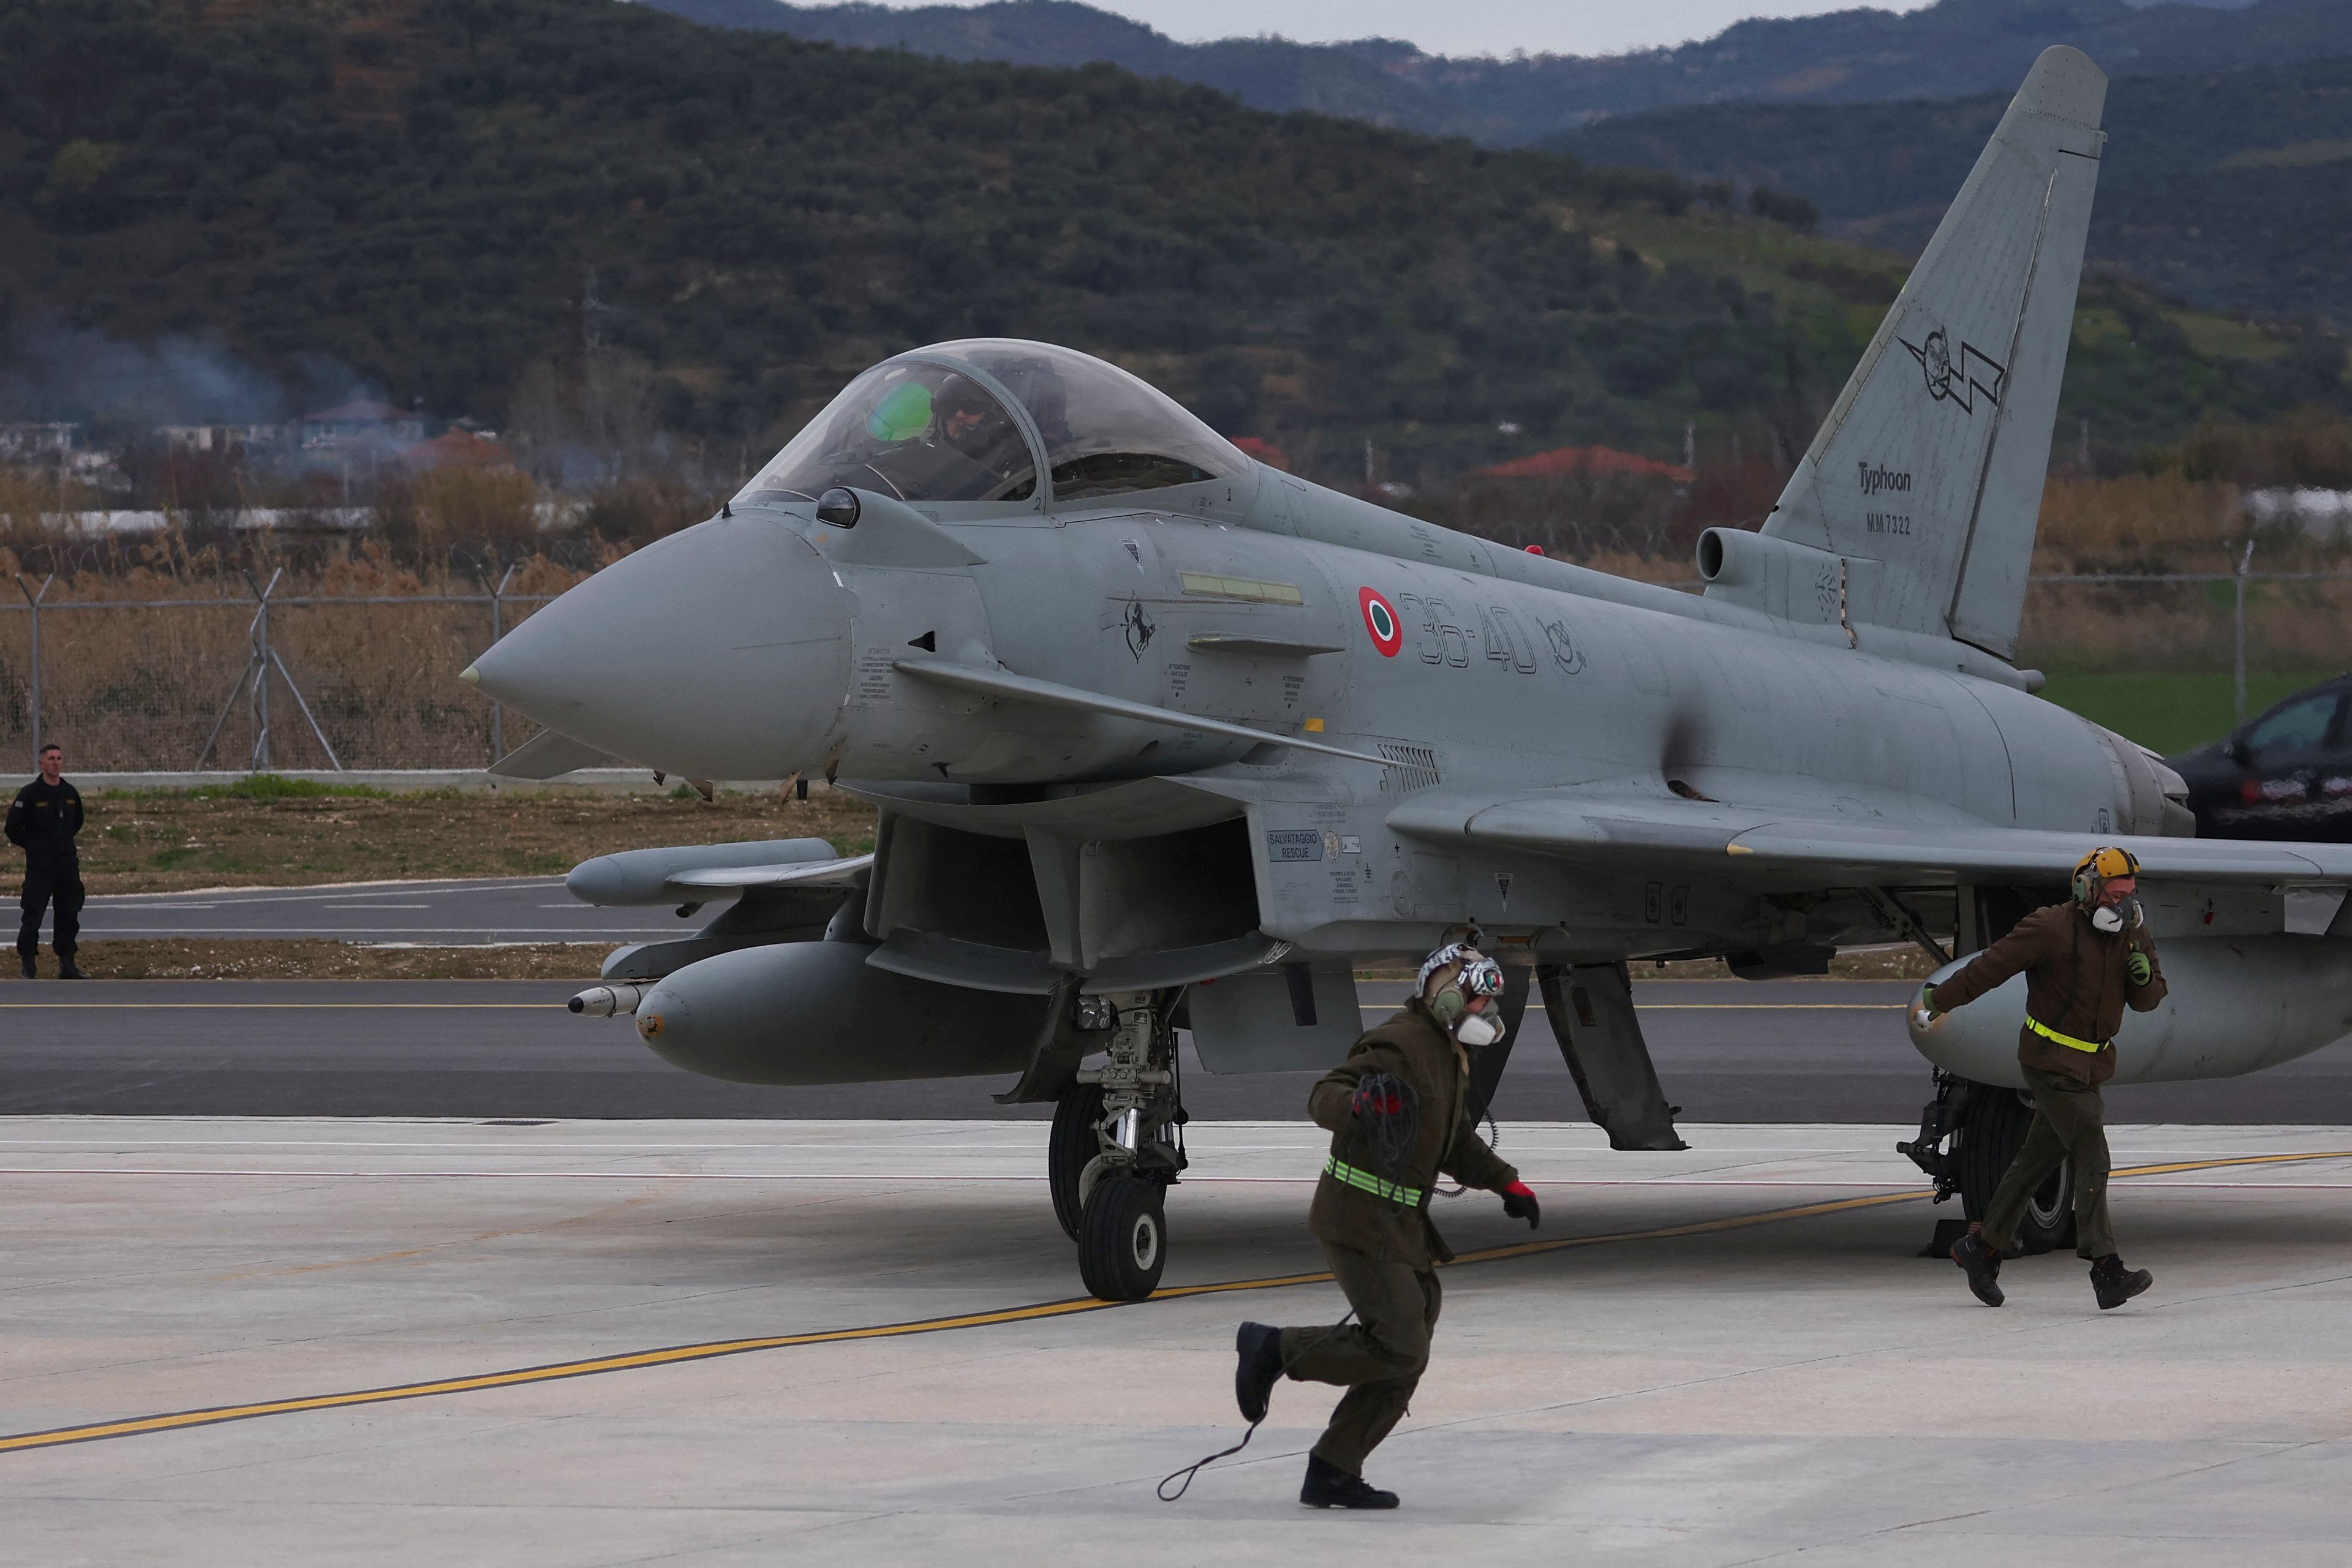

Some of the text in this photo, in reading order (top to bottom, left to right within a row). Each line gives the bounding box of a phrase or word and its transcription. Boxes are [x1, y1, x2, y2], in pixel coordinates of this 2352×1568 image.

[1858, 461, 1911, 495] Typhoon
[1226, 488, 1232, 502] 2
[1033, 497, 1041, 510] 2
[1400, 593, 1537, 674] 36-40
[1270, 834, 1317, 845] SALVATAGGIO
[1282, 847, 1310, 859] RESCUE
